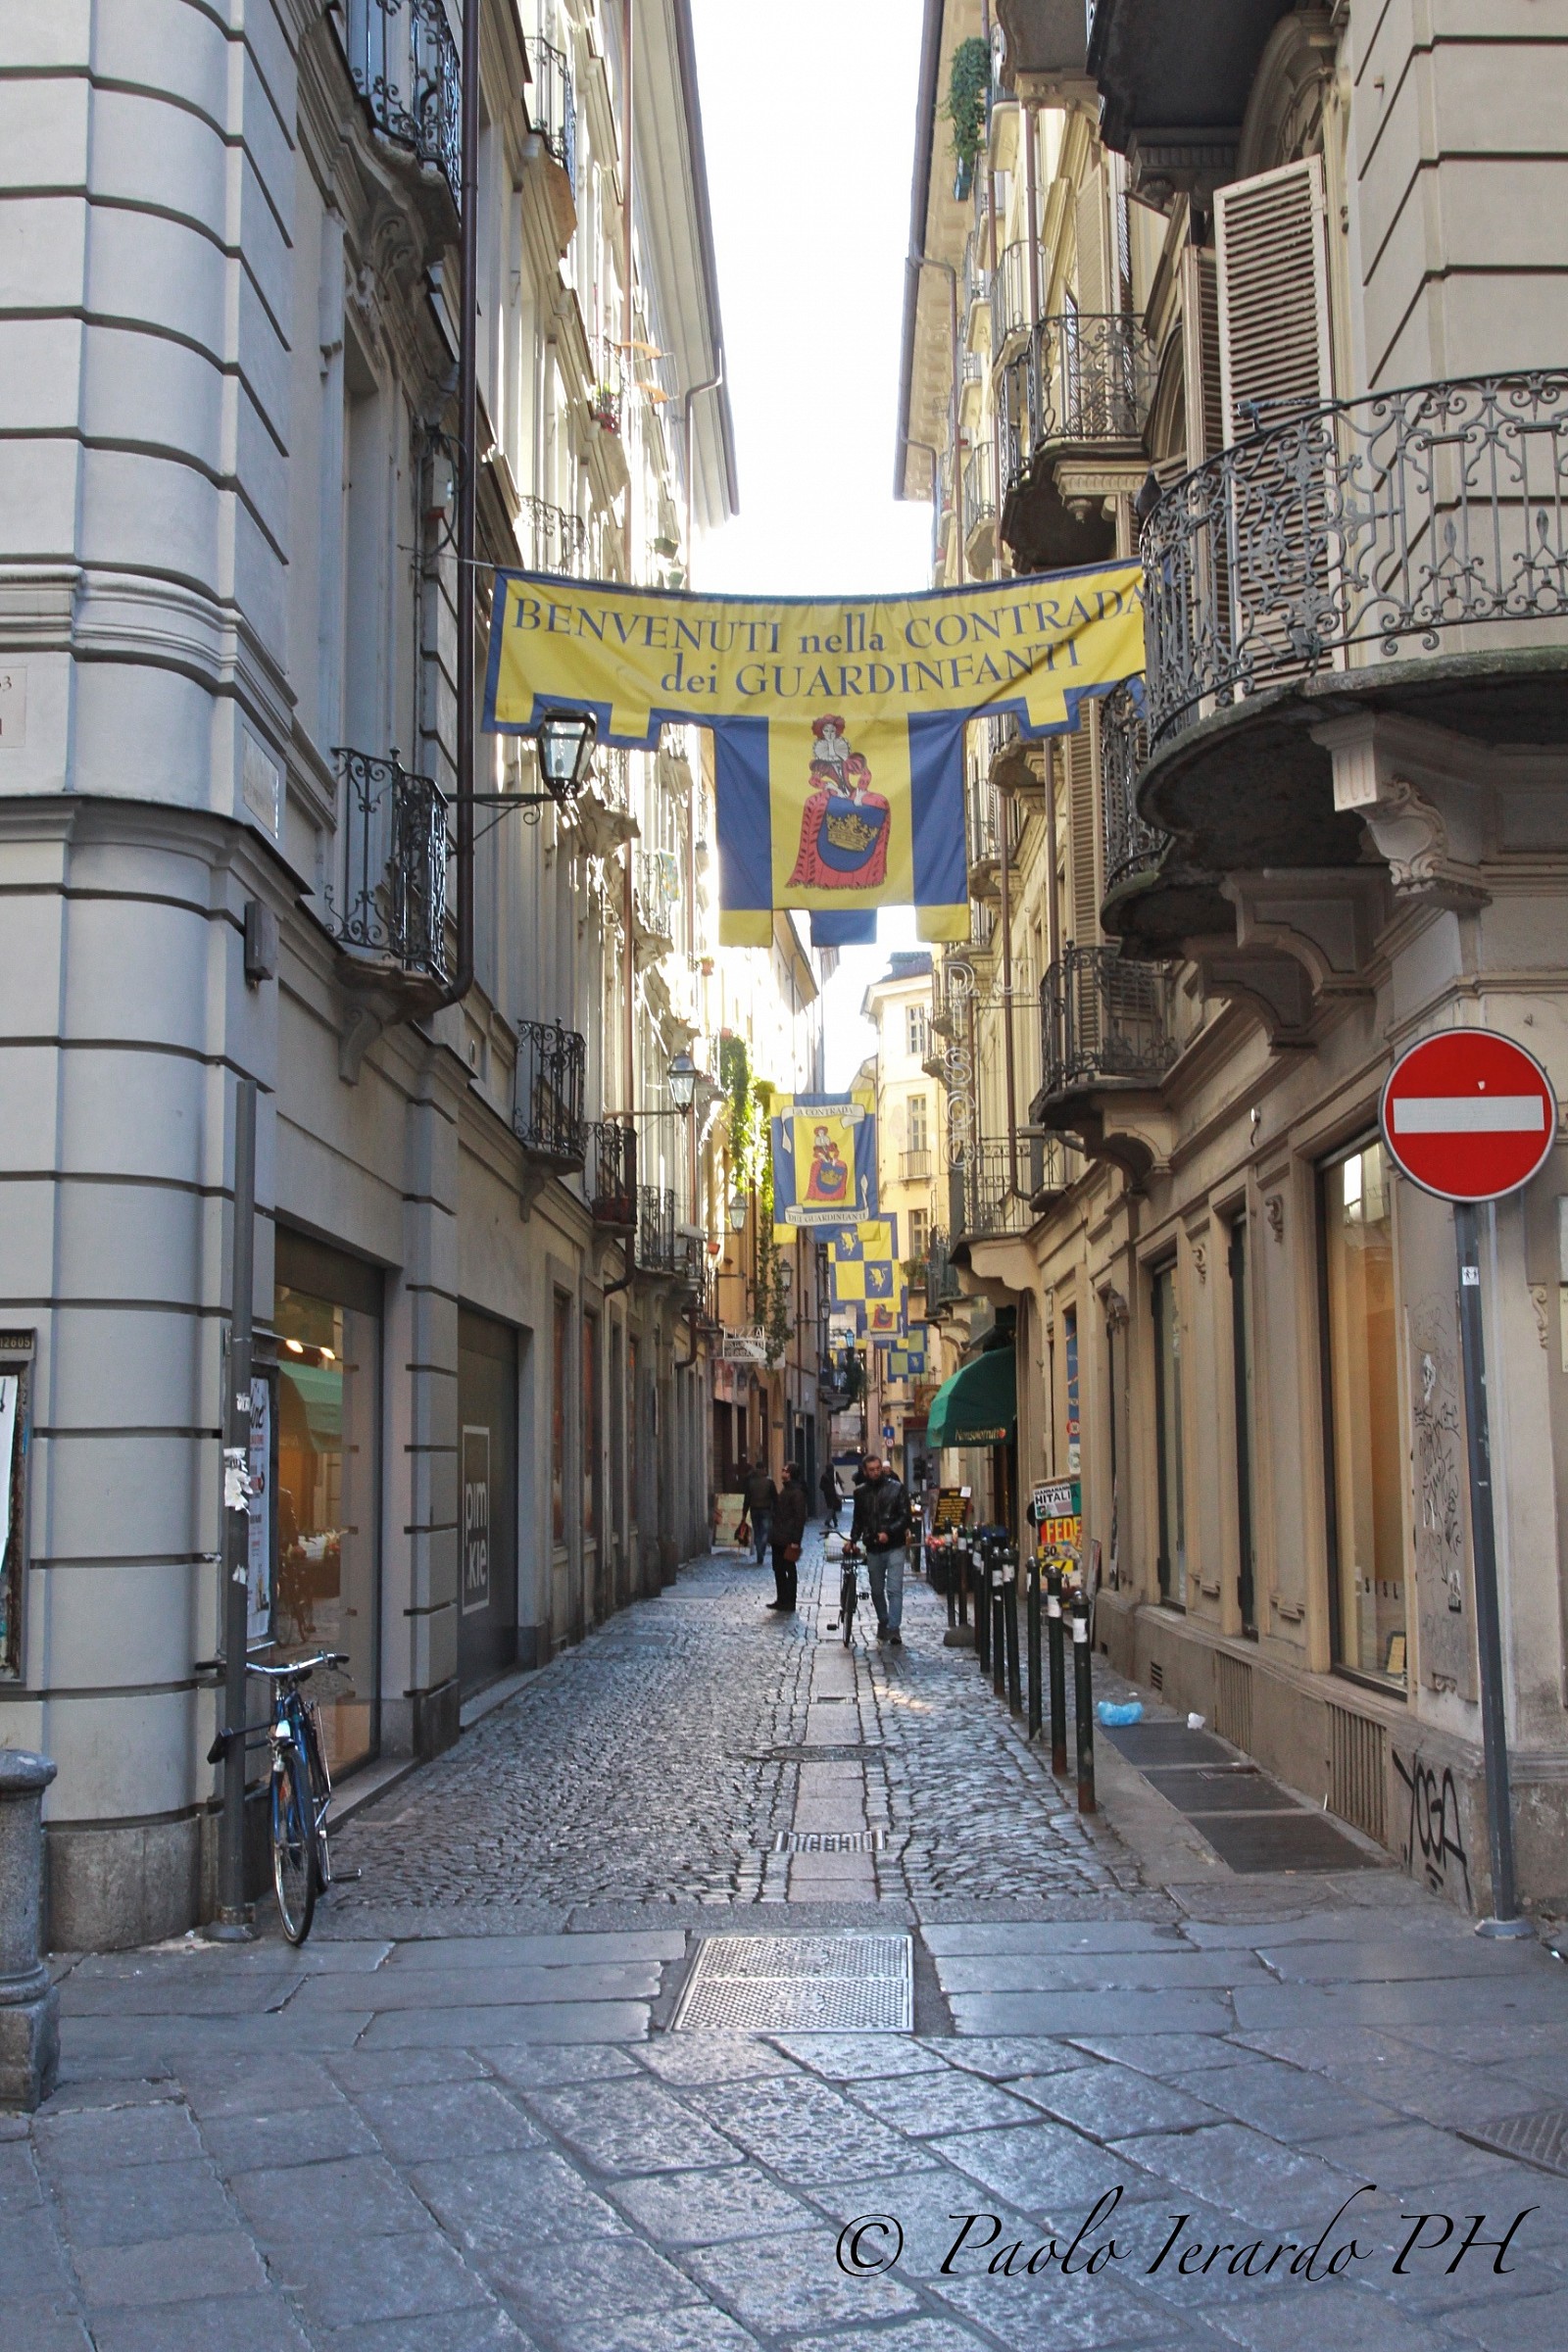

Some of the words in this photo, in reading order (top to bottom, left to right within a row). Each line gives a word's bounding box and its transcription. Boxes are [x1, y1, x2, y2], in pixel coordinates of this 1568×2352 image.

[513, 597, 783, 654] BENVENUTI
[799, 612, 886, 655] nella
[906, 582, 1146, 650] CONTRADA
[661, 652, 718, 694] dei
[736, 638, 1083, 698] GUARDINFANTI
[805, 1104, 854, 1116] CONTRADA
